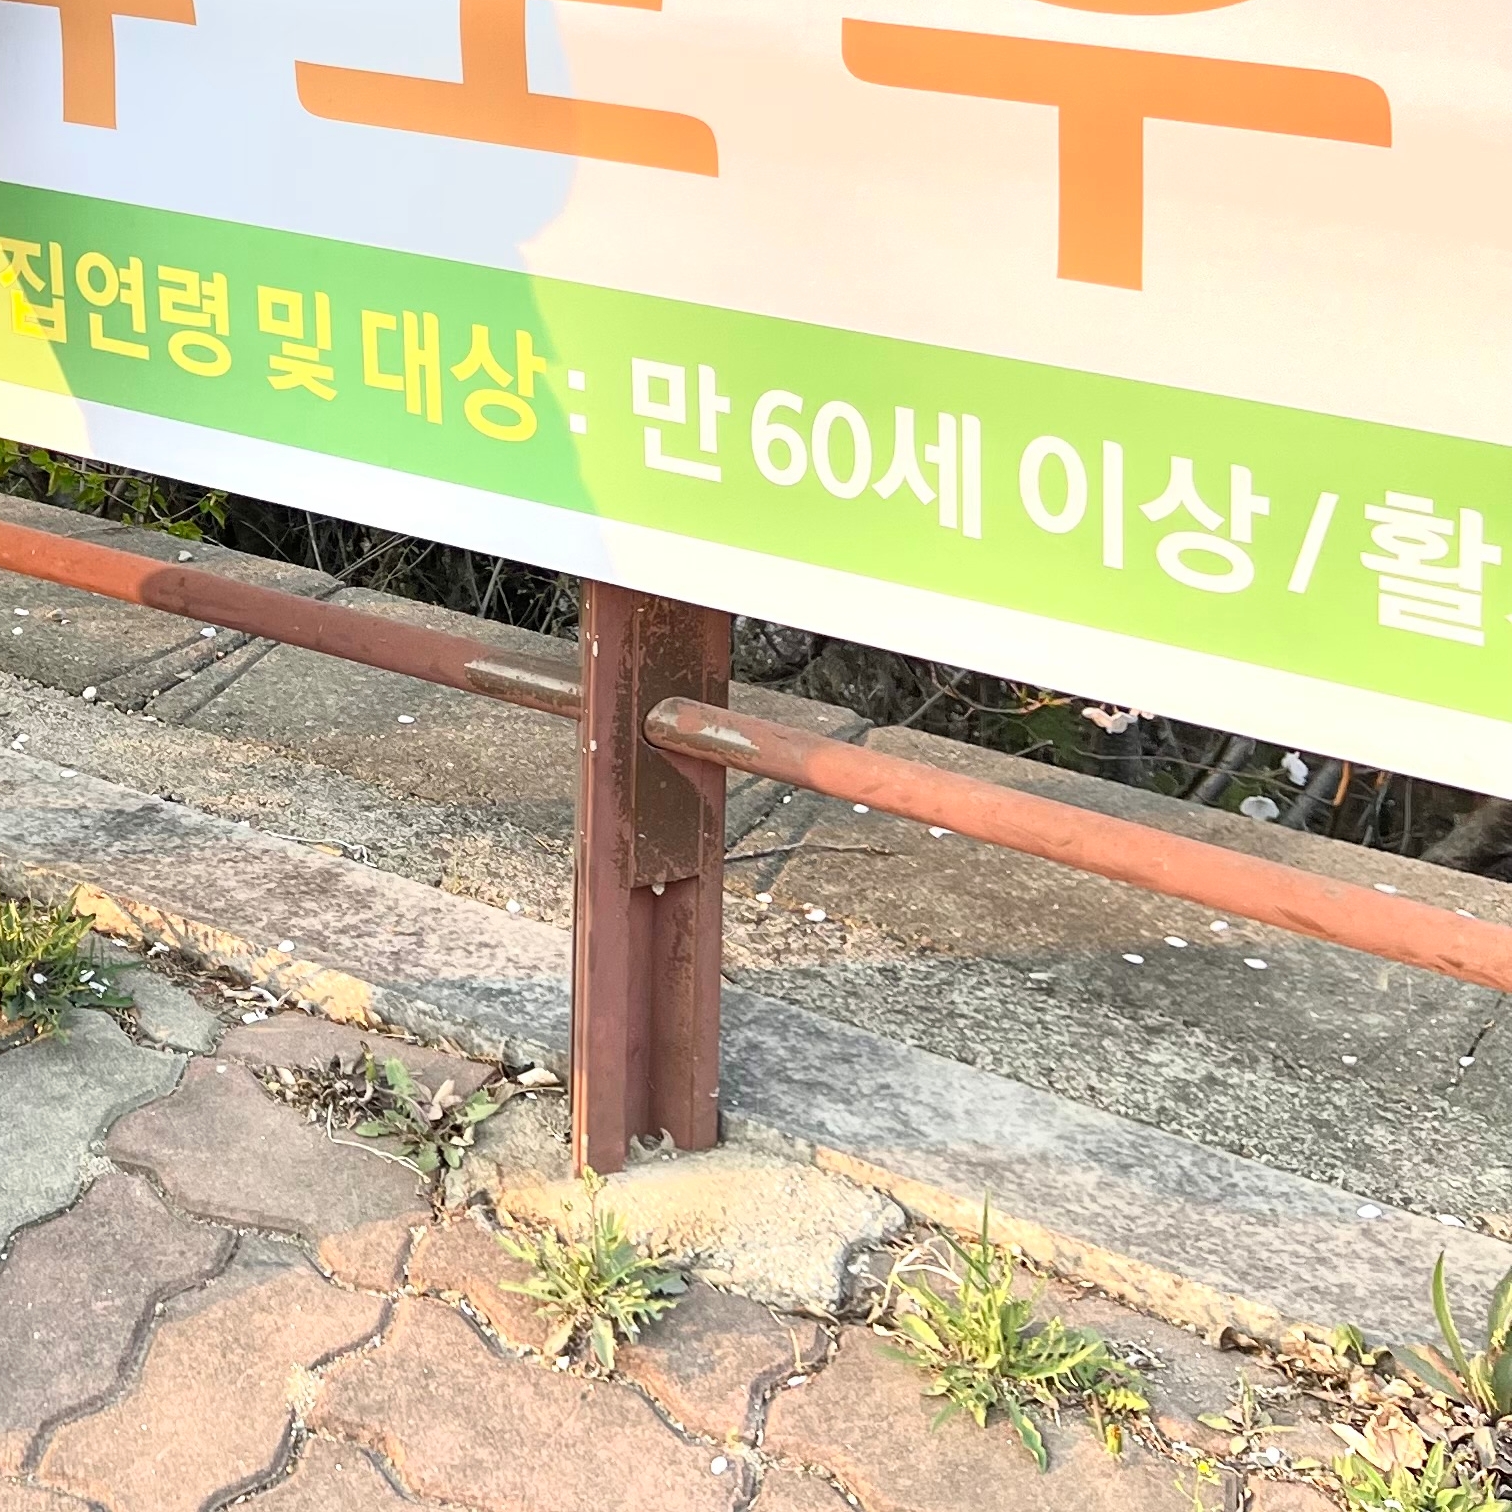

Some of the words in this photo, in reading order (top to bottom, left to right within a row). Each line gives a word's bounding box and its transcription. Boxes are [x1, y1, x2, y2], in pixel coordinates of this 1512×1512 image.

[256, 284, 338, 402] 및
[630, 356, 731, 483] 만
[749, 388, 984, 541] 60세
[1018, 435, 1271, 594] 이상
